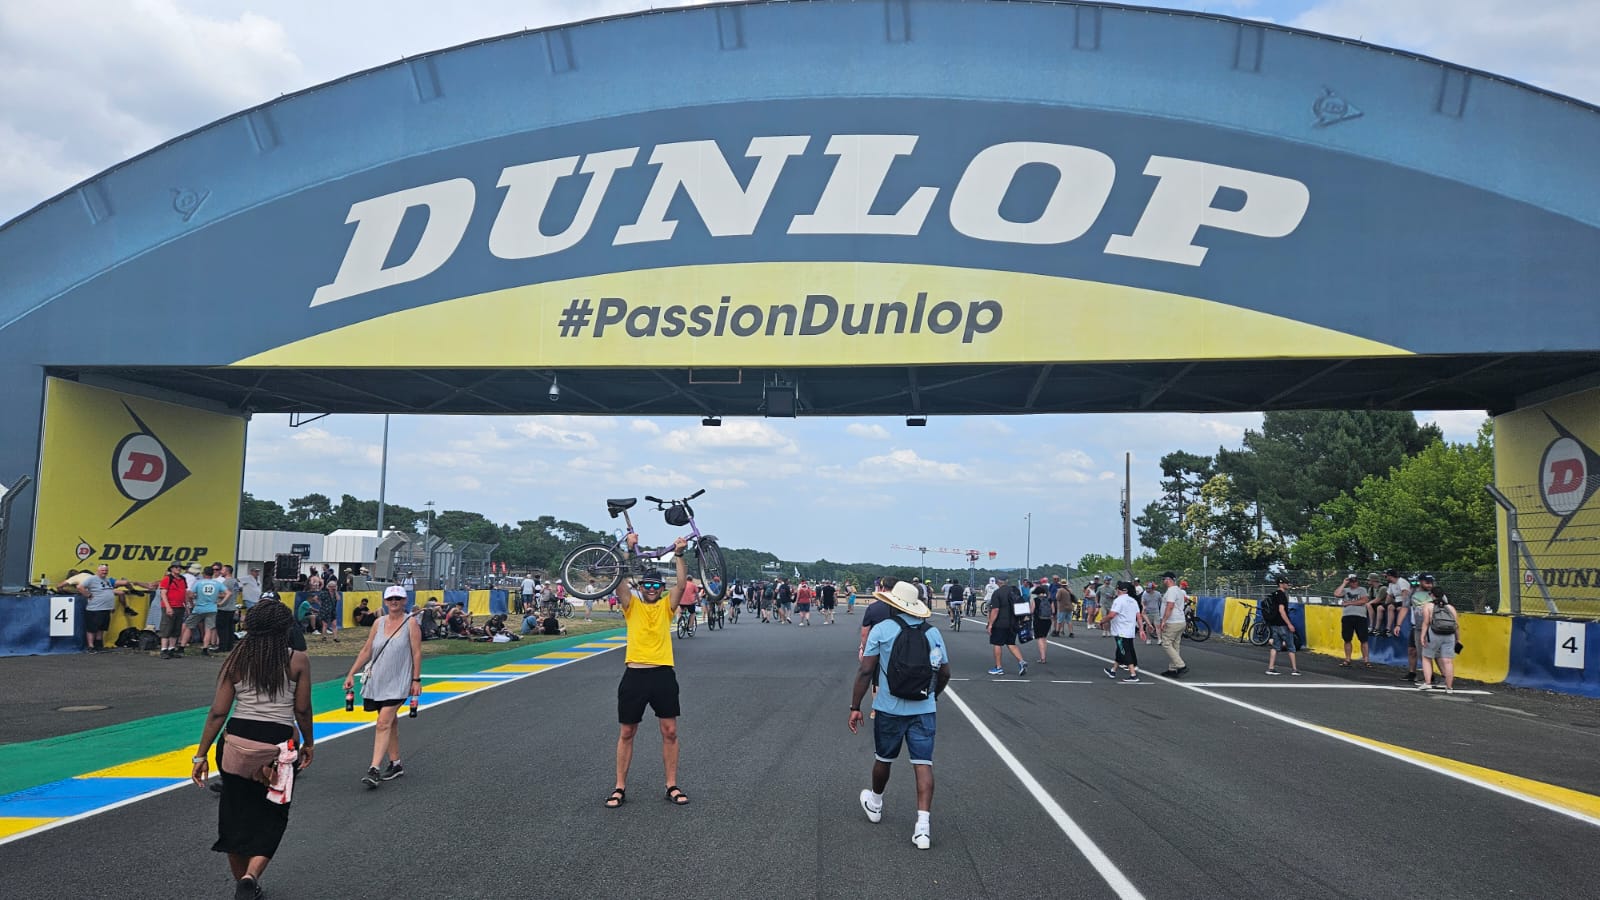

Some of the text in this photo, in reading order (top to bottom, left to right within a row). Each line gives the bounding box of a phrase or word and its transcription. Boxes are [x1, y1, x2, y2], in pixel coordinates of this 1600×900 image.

[309, 133, 1311, 308] DUNLOP
[557, 292, 1004, 344] #PassionDunlop
[122, 451, 165, 483] D
[1547, 458, 1585, 496] D
[98, 543, 209, 562] DUNLOP
[54, 608, 69, 624] 4
[1561, 636, 1578, 654] 4
